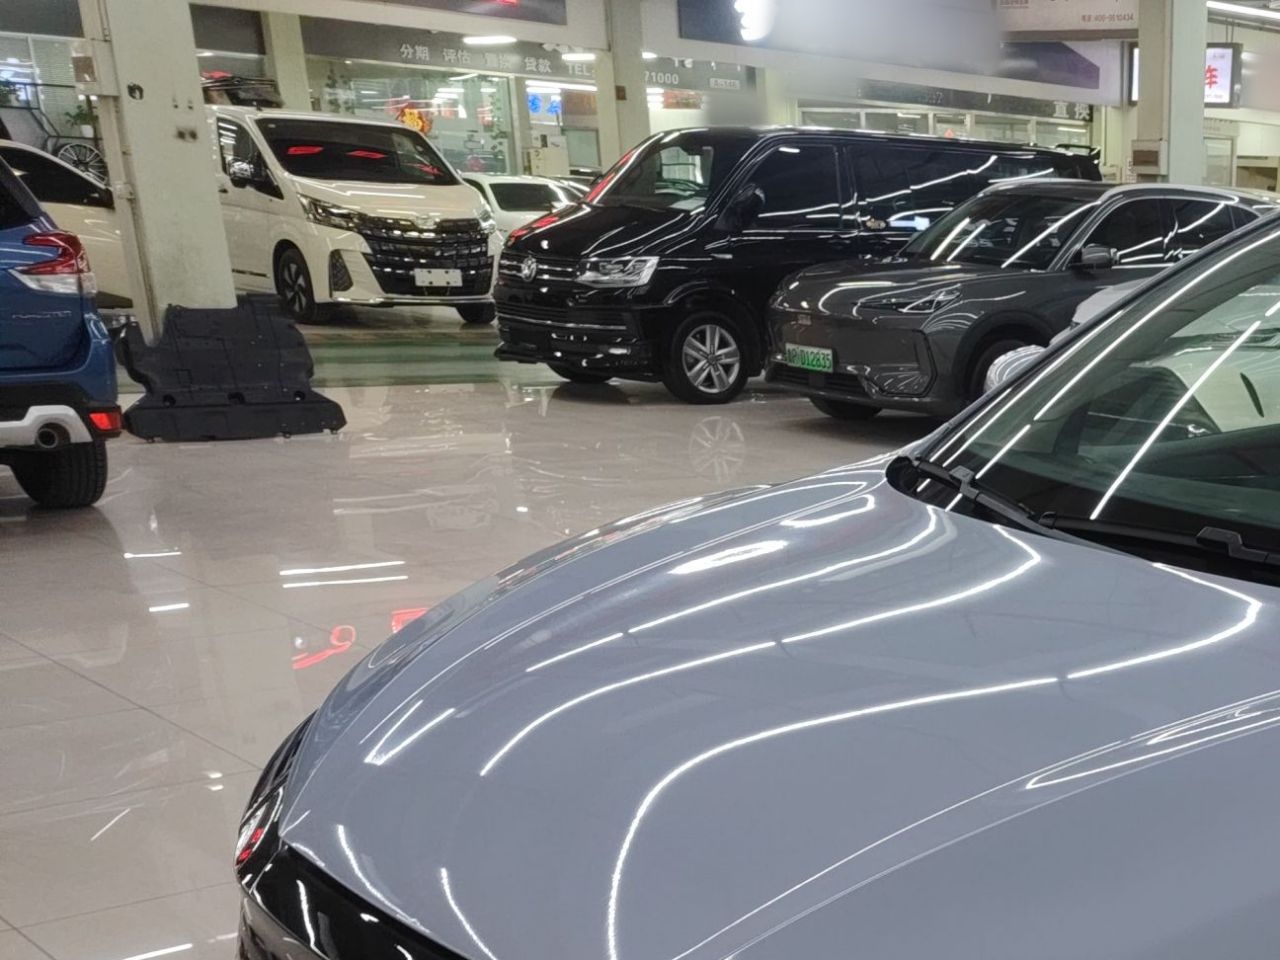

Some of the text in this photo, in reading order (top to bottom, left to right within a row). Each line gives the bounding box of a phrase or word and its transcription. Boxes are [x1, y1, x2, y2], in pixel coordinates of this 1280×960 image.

[400, 44, 430, 61] 分期
[442, 48, 471, 64] 评估
[524, 56, 552, 73] 贷款
